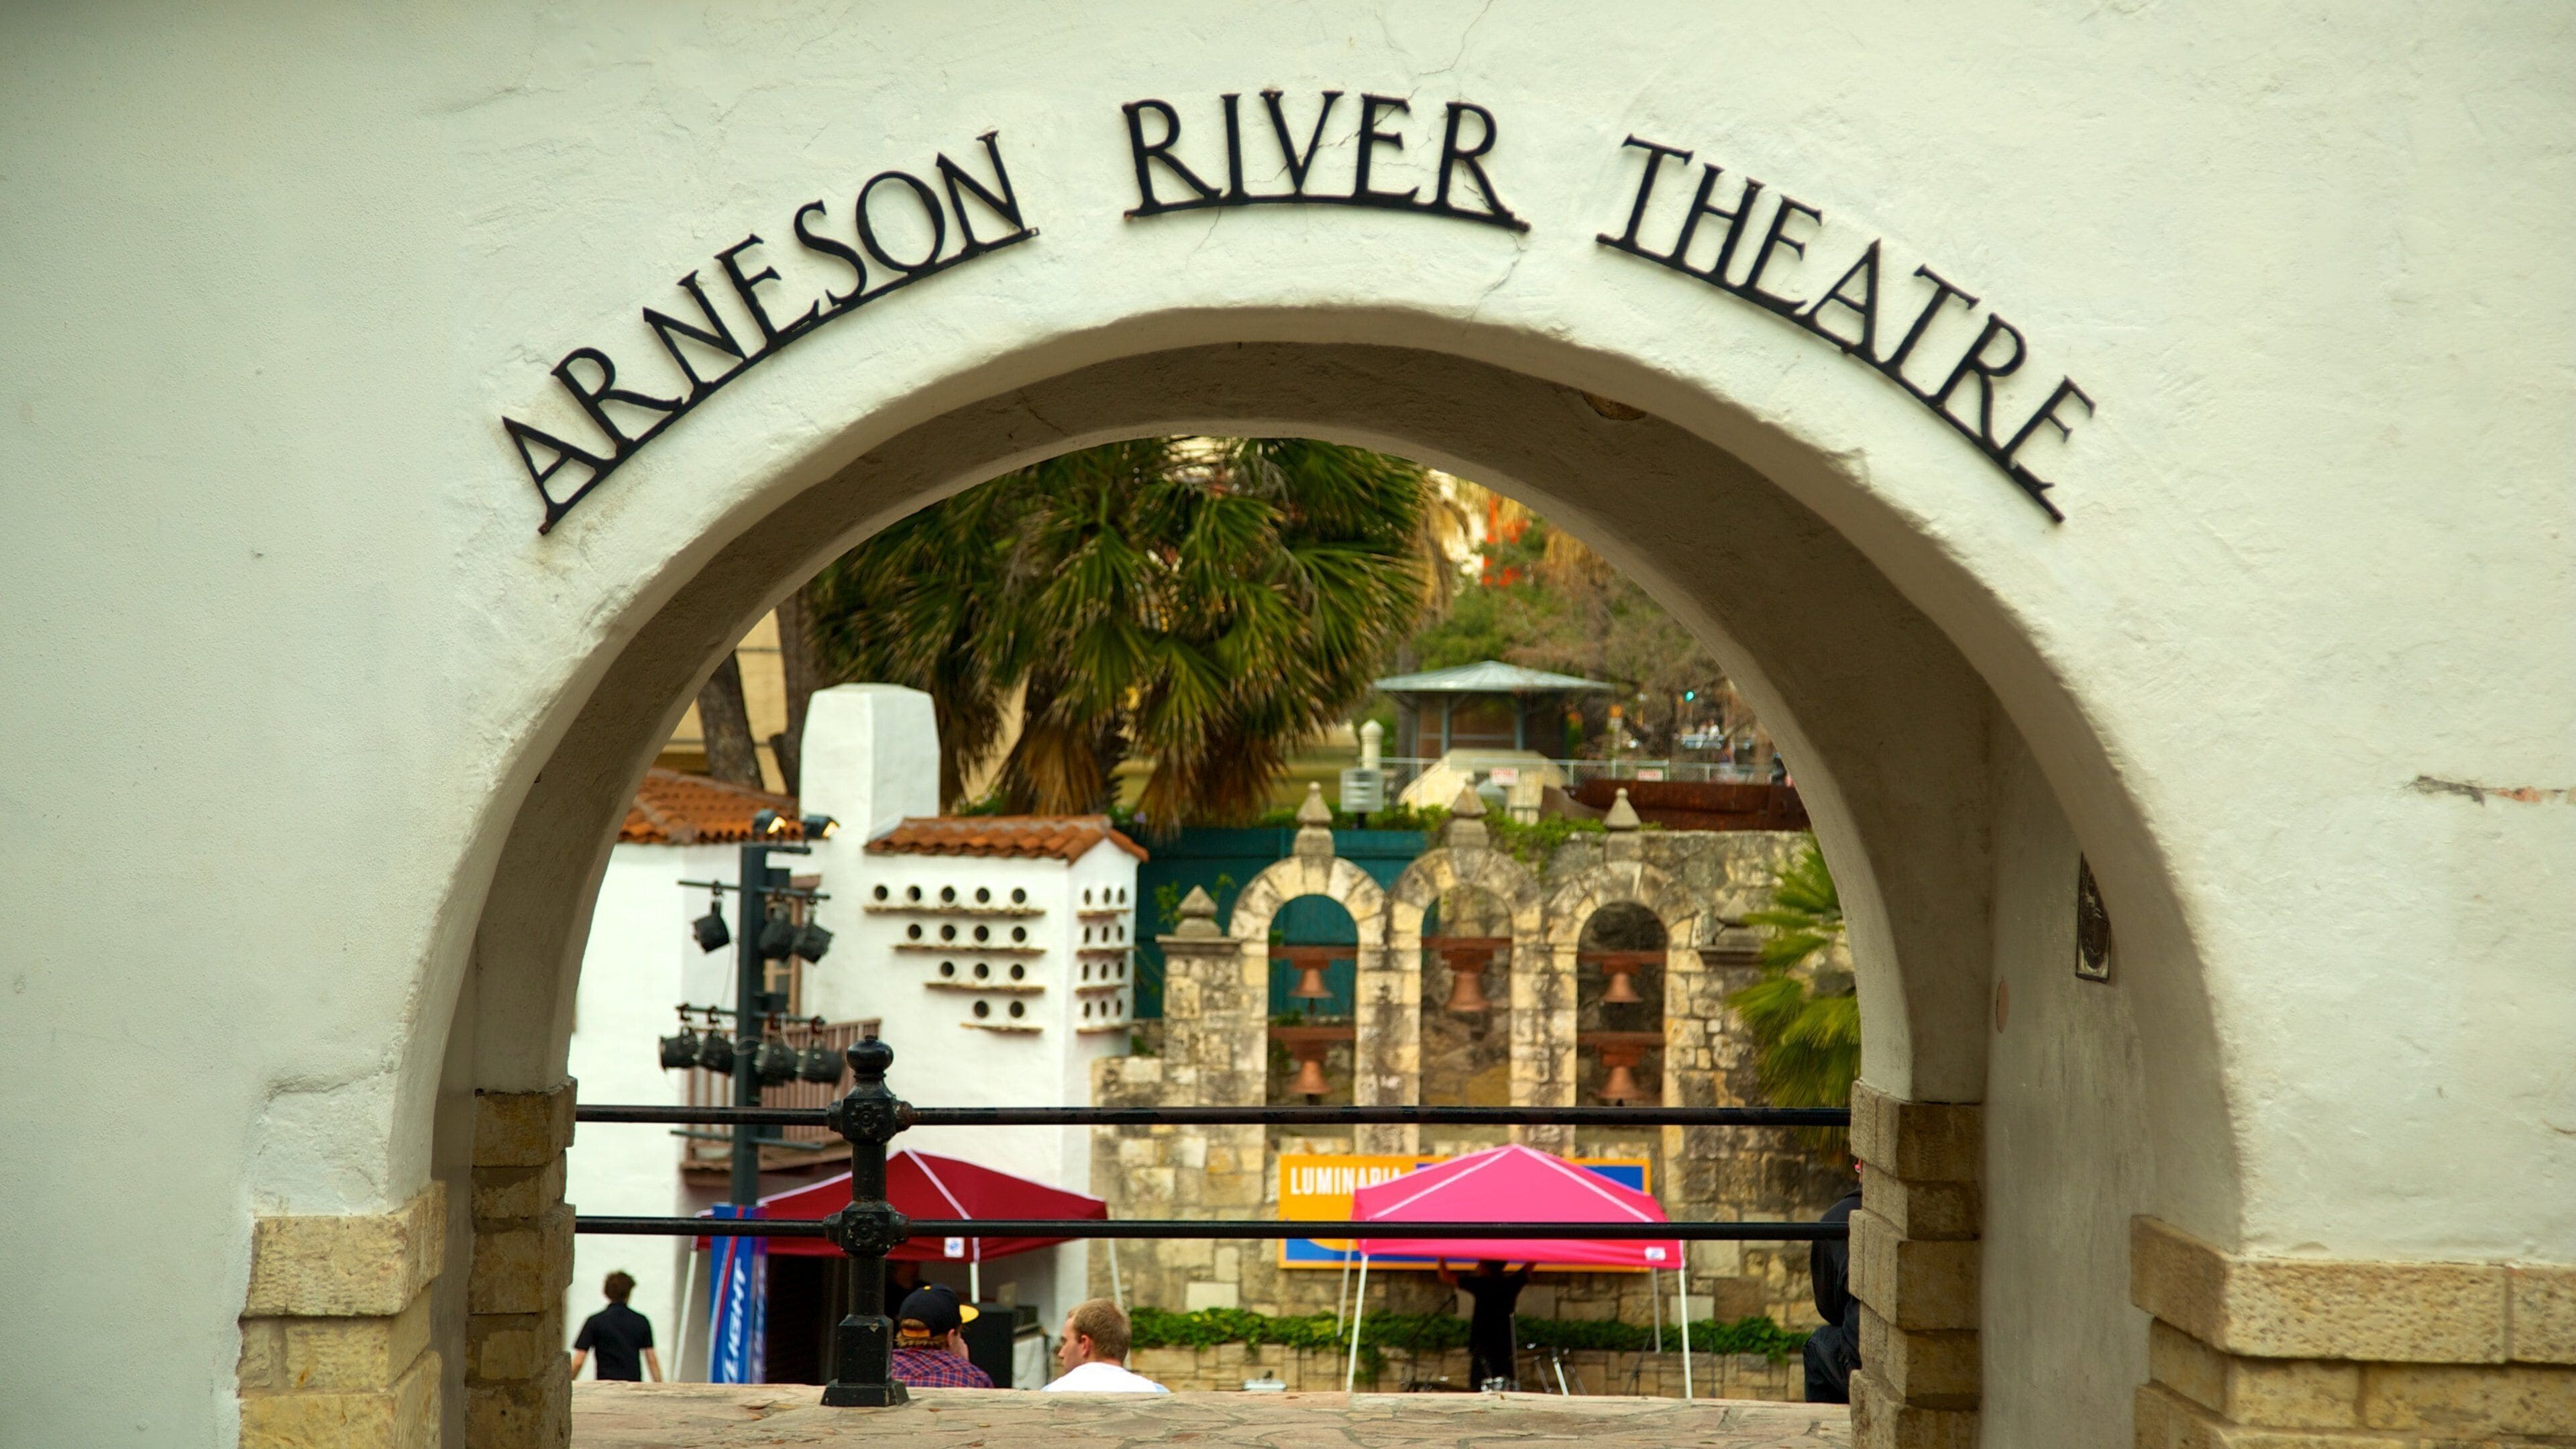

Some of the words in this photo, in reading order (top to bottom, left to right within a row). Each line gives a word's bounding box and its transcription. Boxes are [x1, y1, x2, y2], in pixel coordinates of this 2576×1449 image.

[502, 130, 1038, 535] ARNESON
[1122, 90, 1531, 234] RIVER
[1596, 133, 2095, 523] THEATRE
